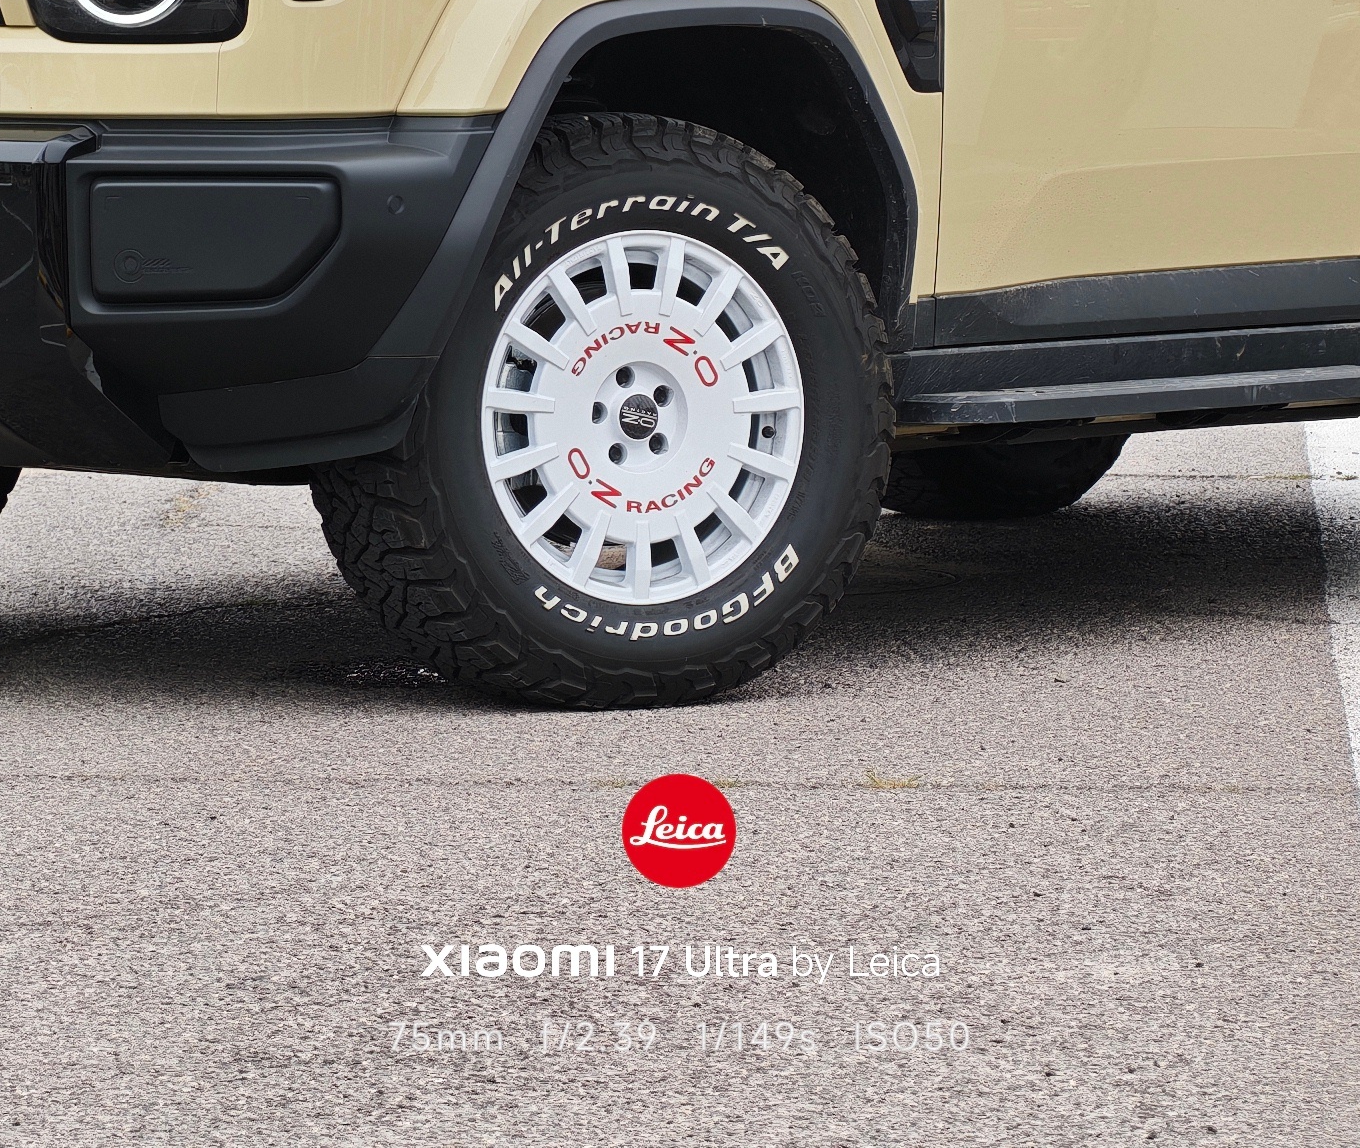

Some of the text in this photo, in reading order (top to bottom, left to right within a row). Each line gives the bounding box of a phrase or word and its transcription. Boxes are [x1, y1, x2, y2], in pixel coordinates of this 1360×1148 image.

[493, 193, 791, 313] All-Terrain T/A
[571, 321, 661, 377] RACING
[626, 457, 716, 514] RACING
[533, 542, 801, 642] BFGoodrich
